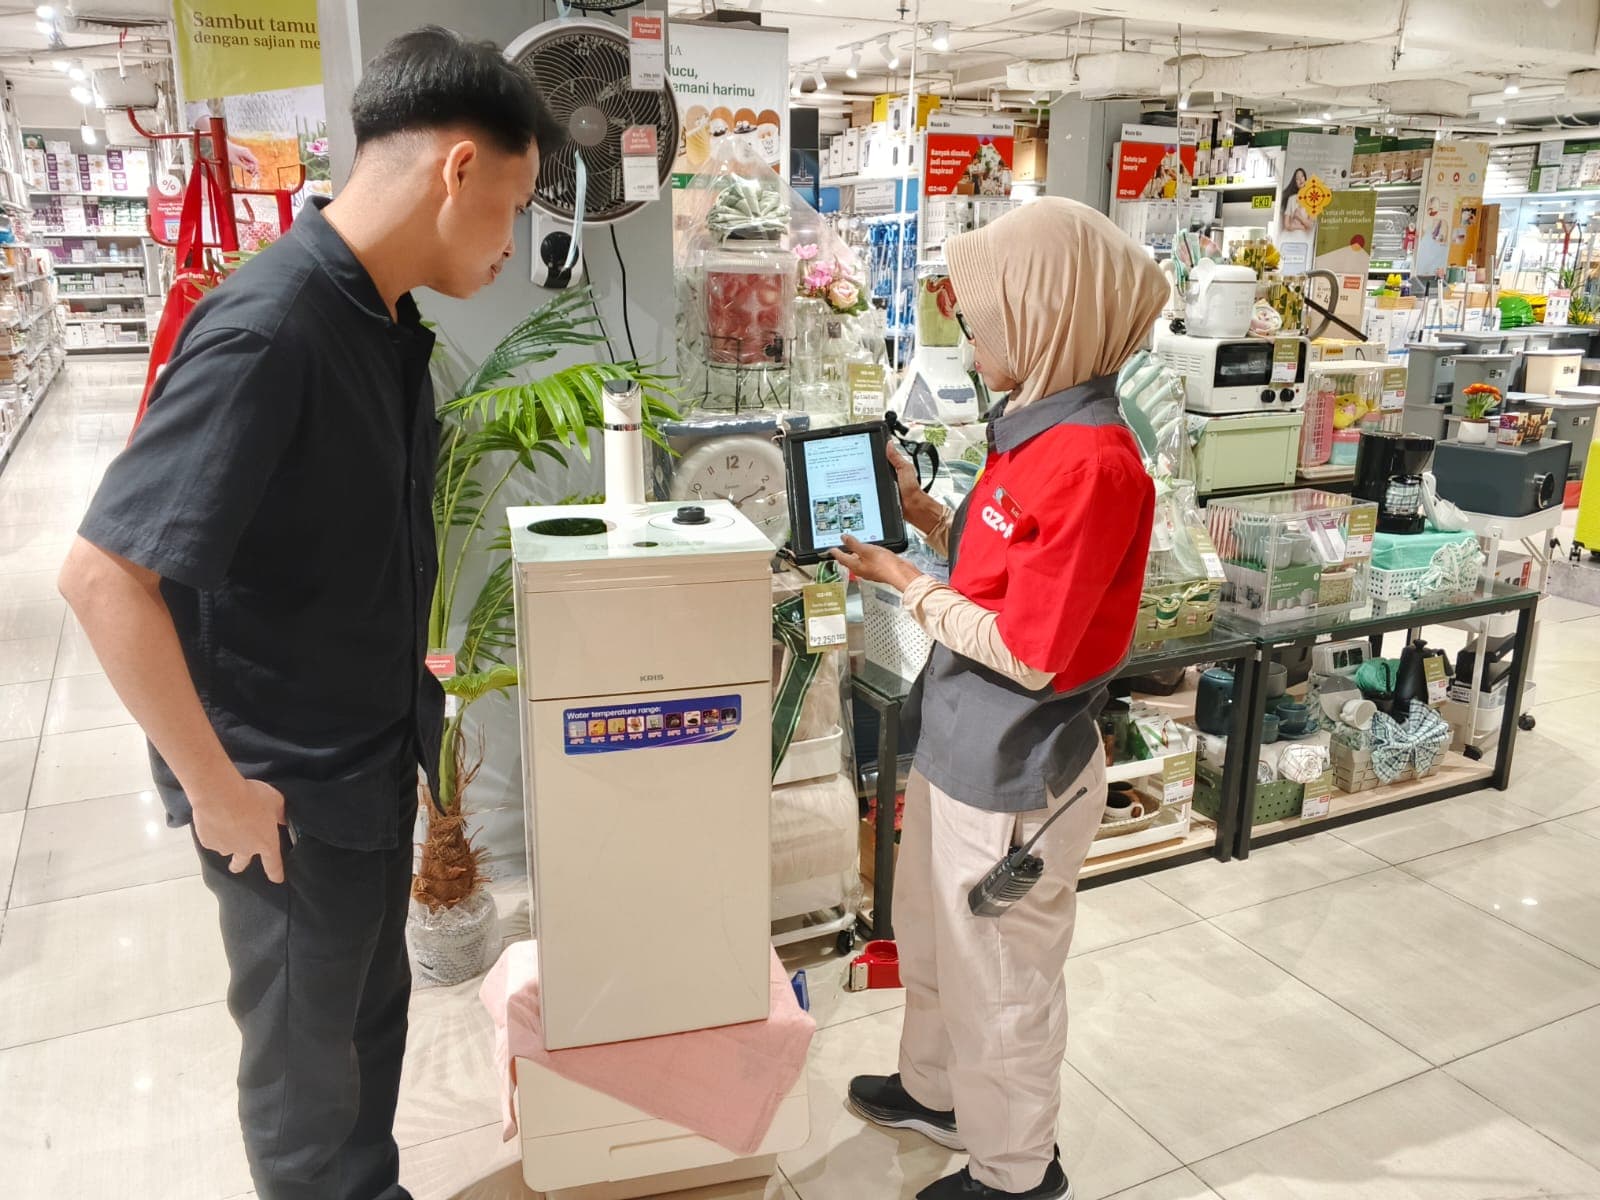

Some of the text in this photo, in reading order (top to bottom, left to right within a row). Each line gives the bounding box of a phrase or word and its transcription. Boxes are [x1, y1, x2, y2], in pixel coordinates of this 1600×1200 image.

[193, 11, 316, 34] Sambut tamu
[193, 31, 249, 48] dengan
[254, 34, 295, 50] sajian
[713, 83, 755, 97] harimu
[725, 455, 740, 469] 12
[640, 674, 664, 682] KRIS
[566, 706, 662, 721] Water temperature range:
